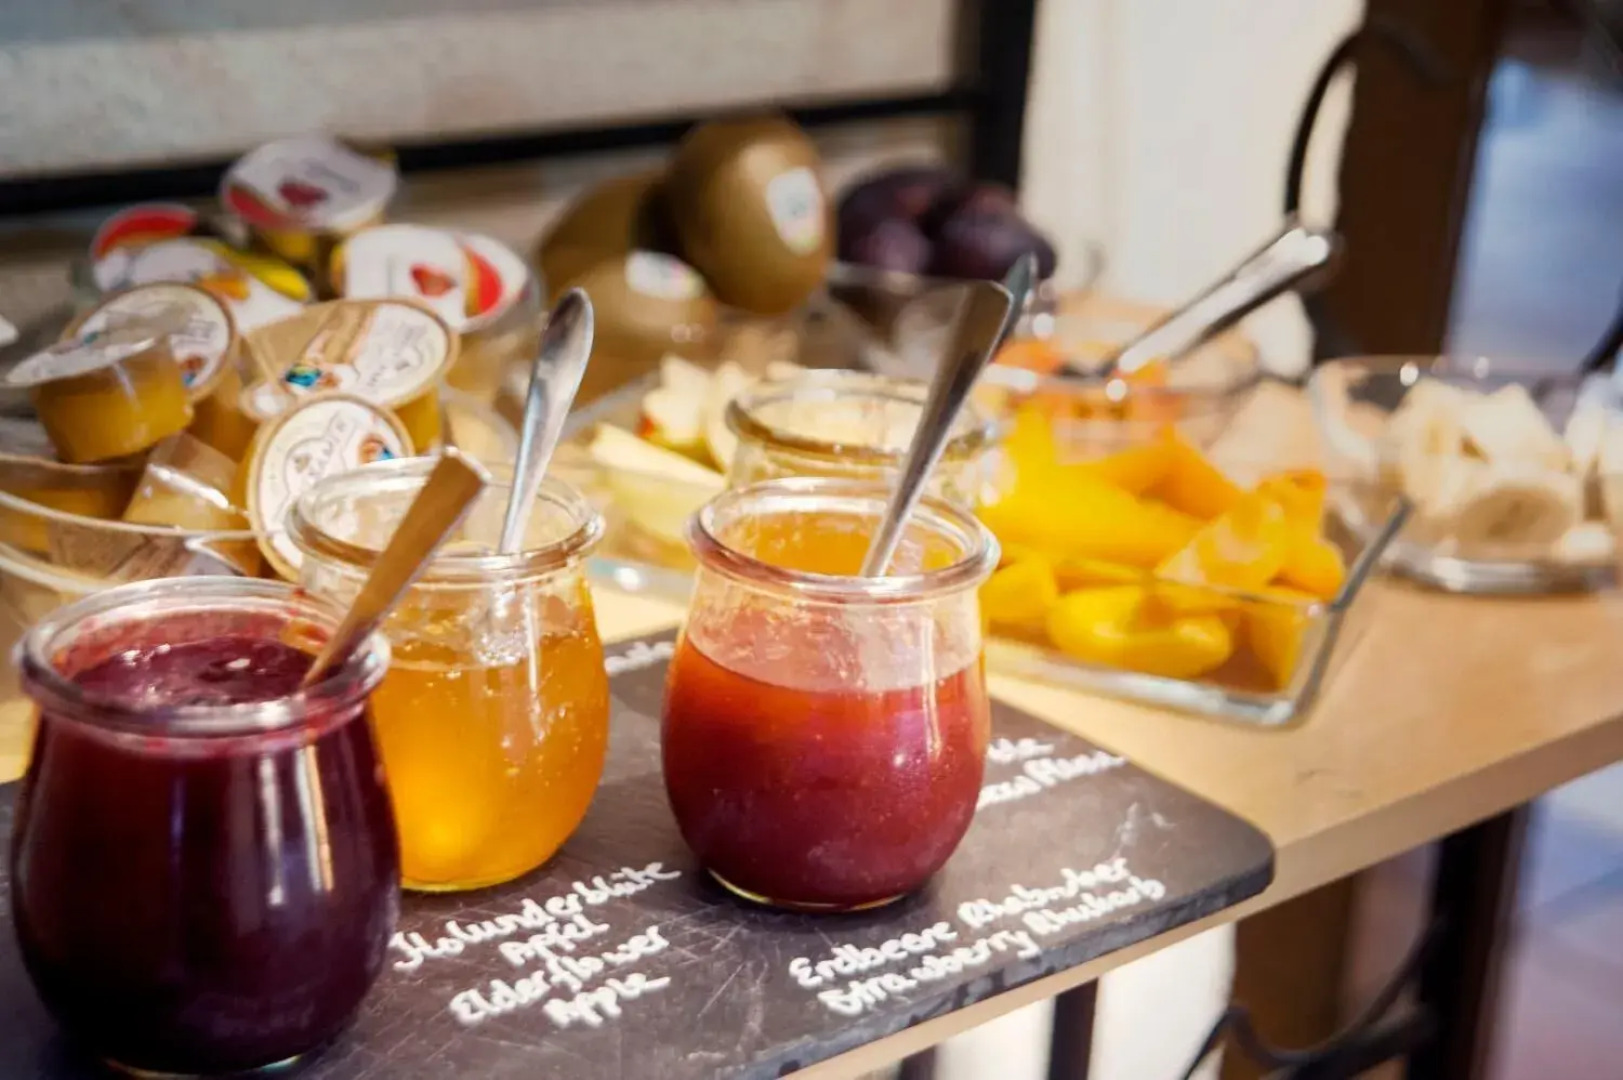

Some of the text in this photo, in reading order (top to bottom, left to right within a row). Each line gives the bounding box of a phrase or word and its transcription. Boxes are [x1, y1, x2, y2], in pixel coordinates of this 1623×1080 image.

[499, 913, 610, 967] Apfel
[789, 921, 958, 988] Erdbeere
[818, 875, 1166, 1016] Strawberry Rhubarb
[450, 924, 670, 1025] Elderflower
[543, 972, 672, 1028] Apple
